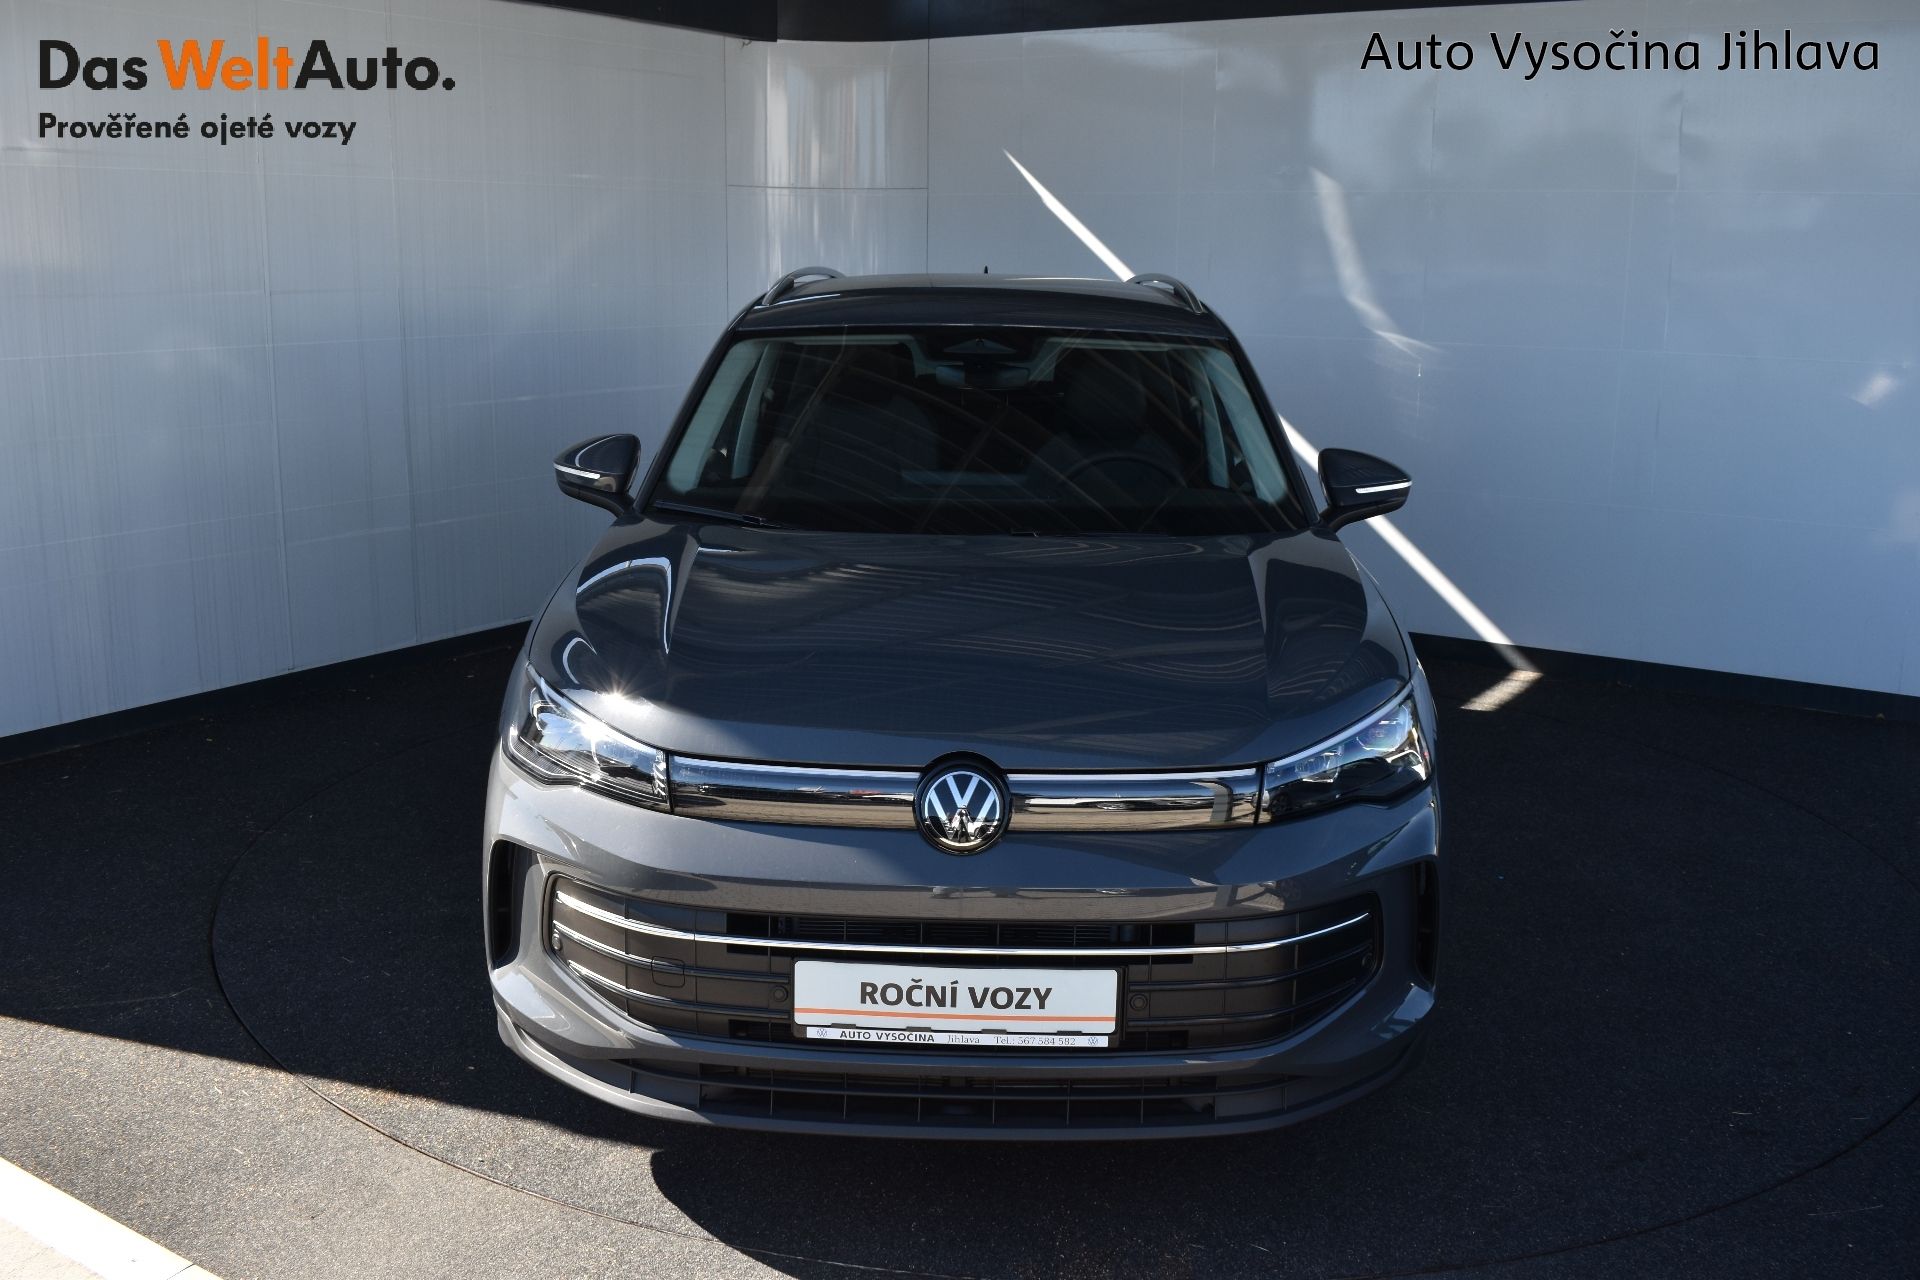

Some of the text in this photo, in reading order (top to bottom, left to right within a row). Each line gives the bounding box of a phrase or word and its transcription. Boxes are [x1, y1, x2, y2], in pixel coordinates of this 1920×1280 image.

[860, 978, 1053, 1010] ROČNÍ VOZY
[840, 1030, 871, 1040] AUTO
[947, 1034, 980, 1044] Jihlava
[994, 1035, 1015, 1045] Tel.:
